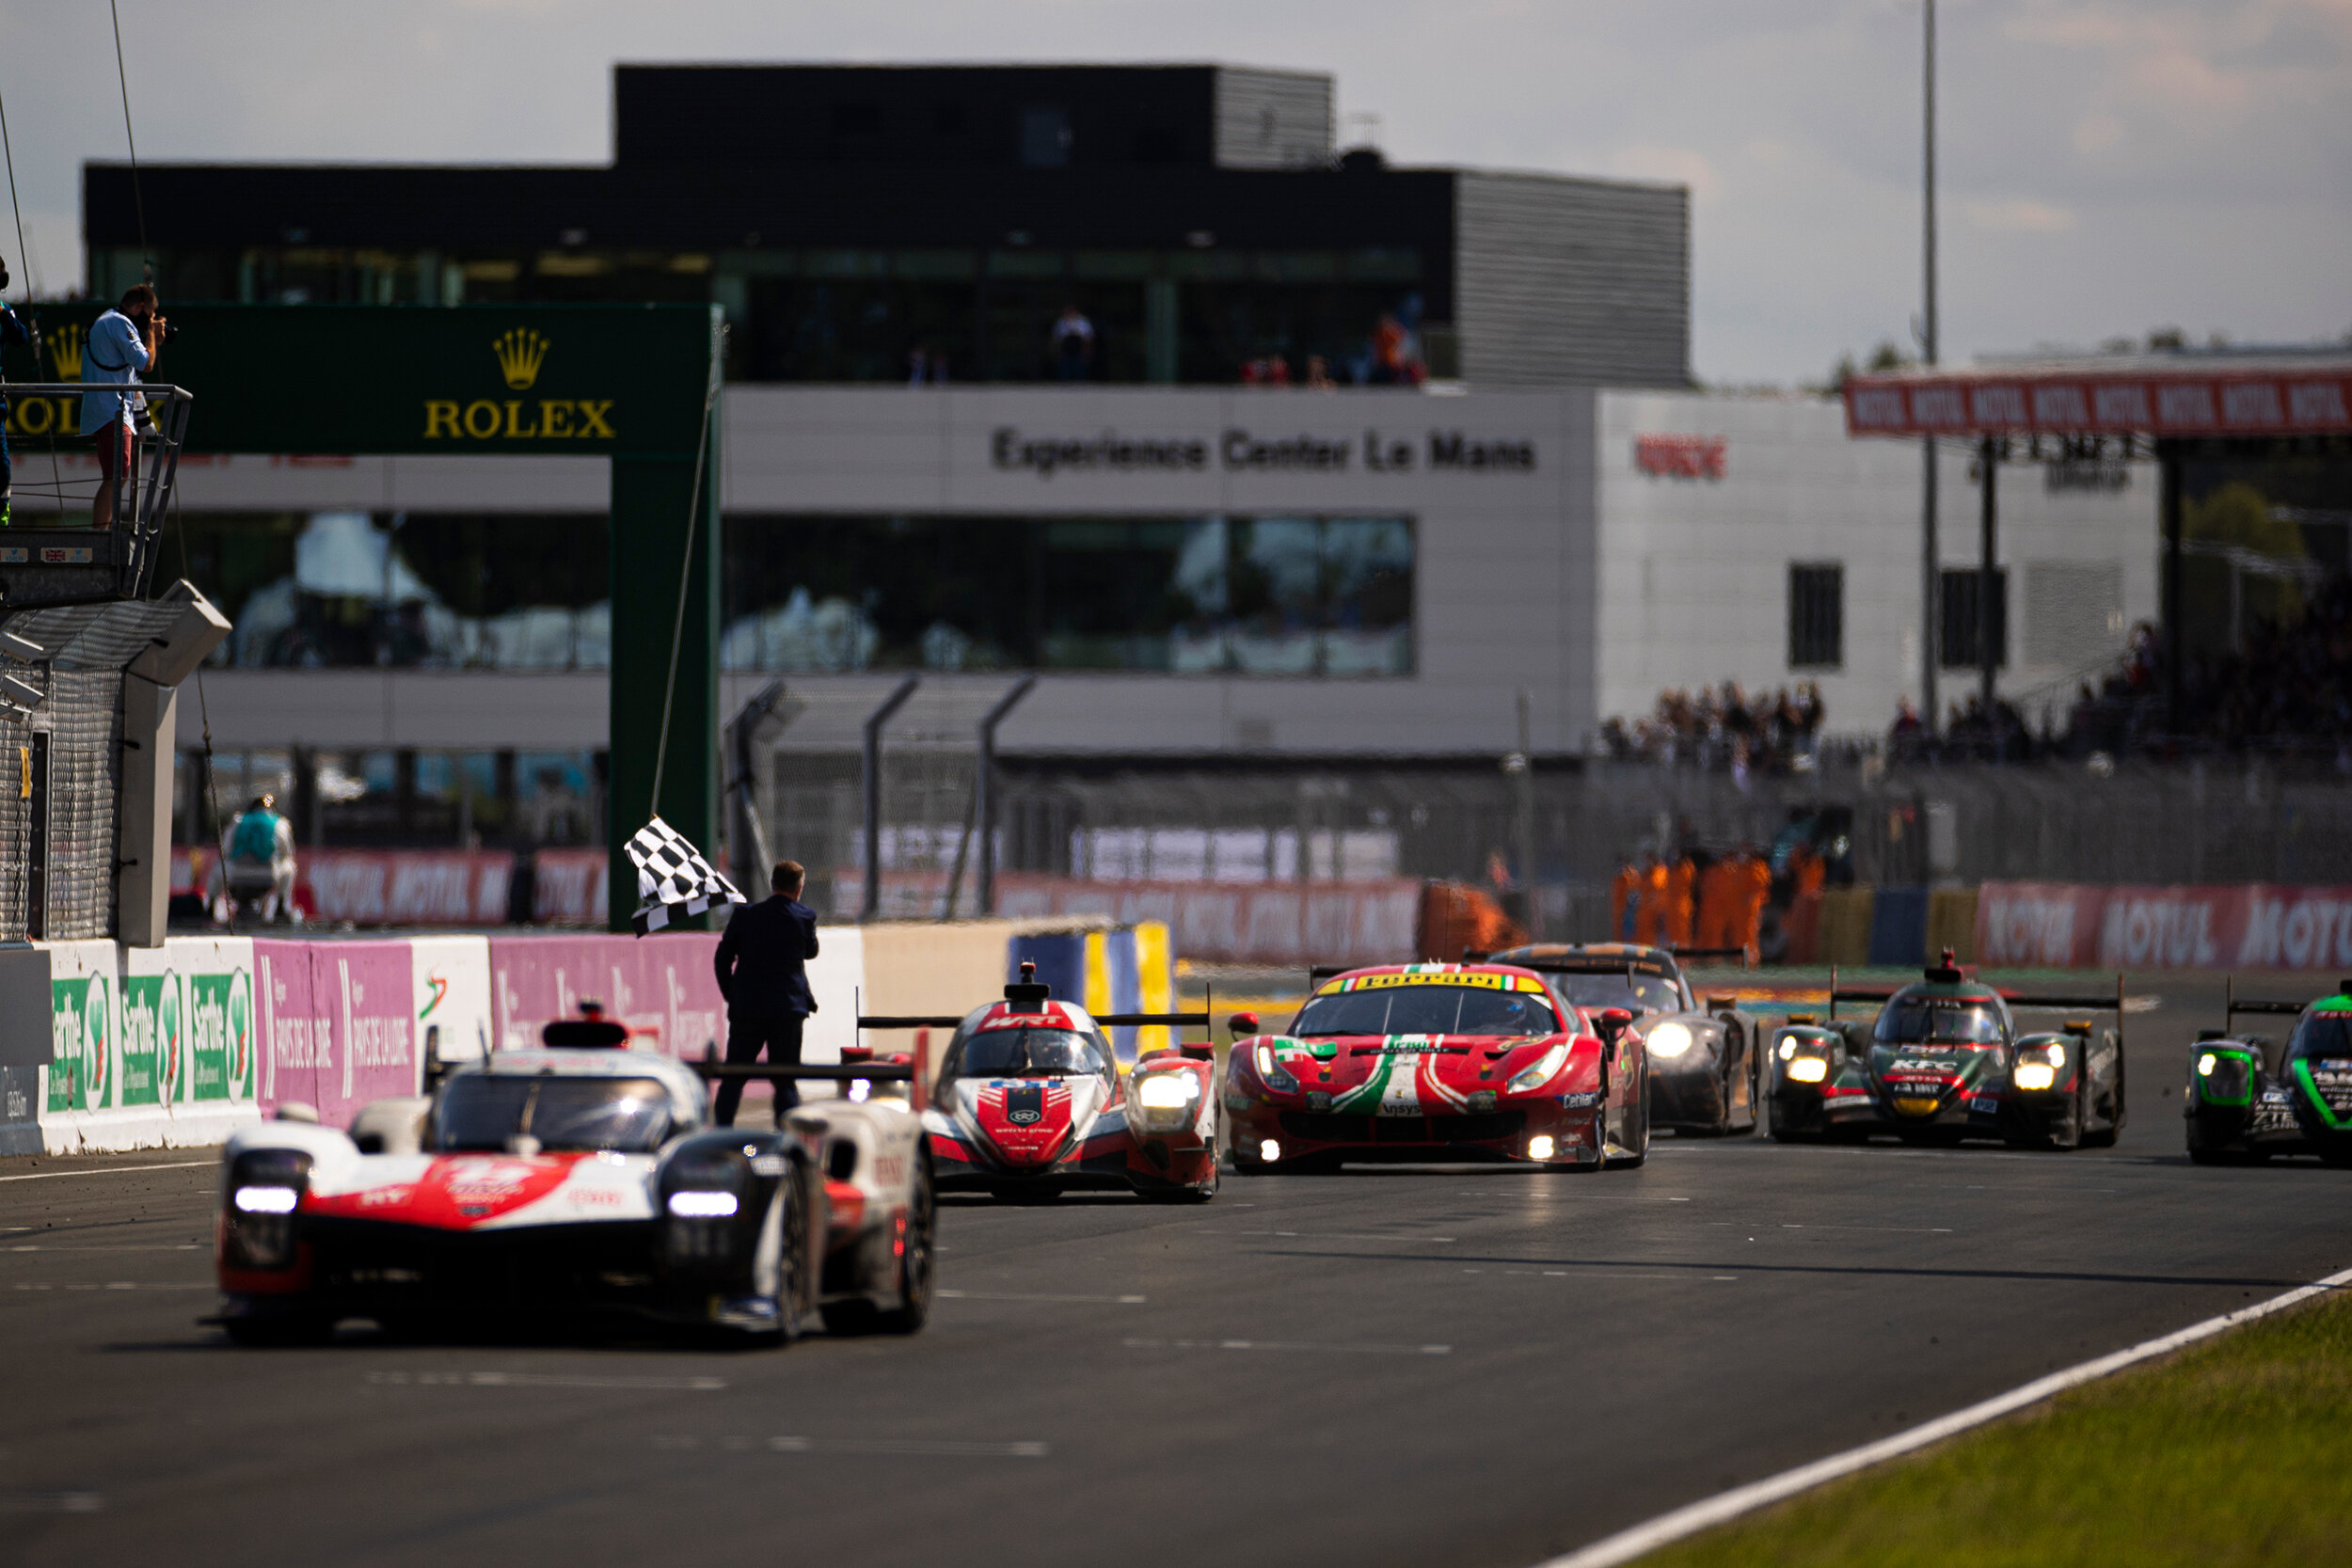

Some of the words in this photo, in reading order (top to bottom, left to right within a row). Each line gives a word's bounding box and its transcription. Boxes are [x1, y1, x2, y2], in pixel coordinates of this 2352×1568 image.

[423, 399, 615, 439] ROLEX
[992, 427, 1208, 481] Experience
[1221, 427, 1350, 472] Center
[1363, 427, 1413, 472] Le
[1427, 427, 1537, 473] Mans
[2101, 898, 2214, 966] MOTUL
[1362, 973, 1495, 988] Ferrari
[53, 992, 82, 1059] arthe
[122, 989, 154, 1055] Sarthe
[192, 986, 225, 1052] Sarthe
[984, 1015, 1062, 1028] WRT
[1890, 1059, 1958, 1070] KFC
[1378, 1103, 1421, 1117] Ansys
[1563, 1093, 1596, 1109] Cetilar
